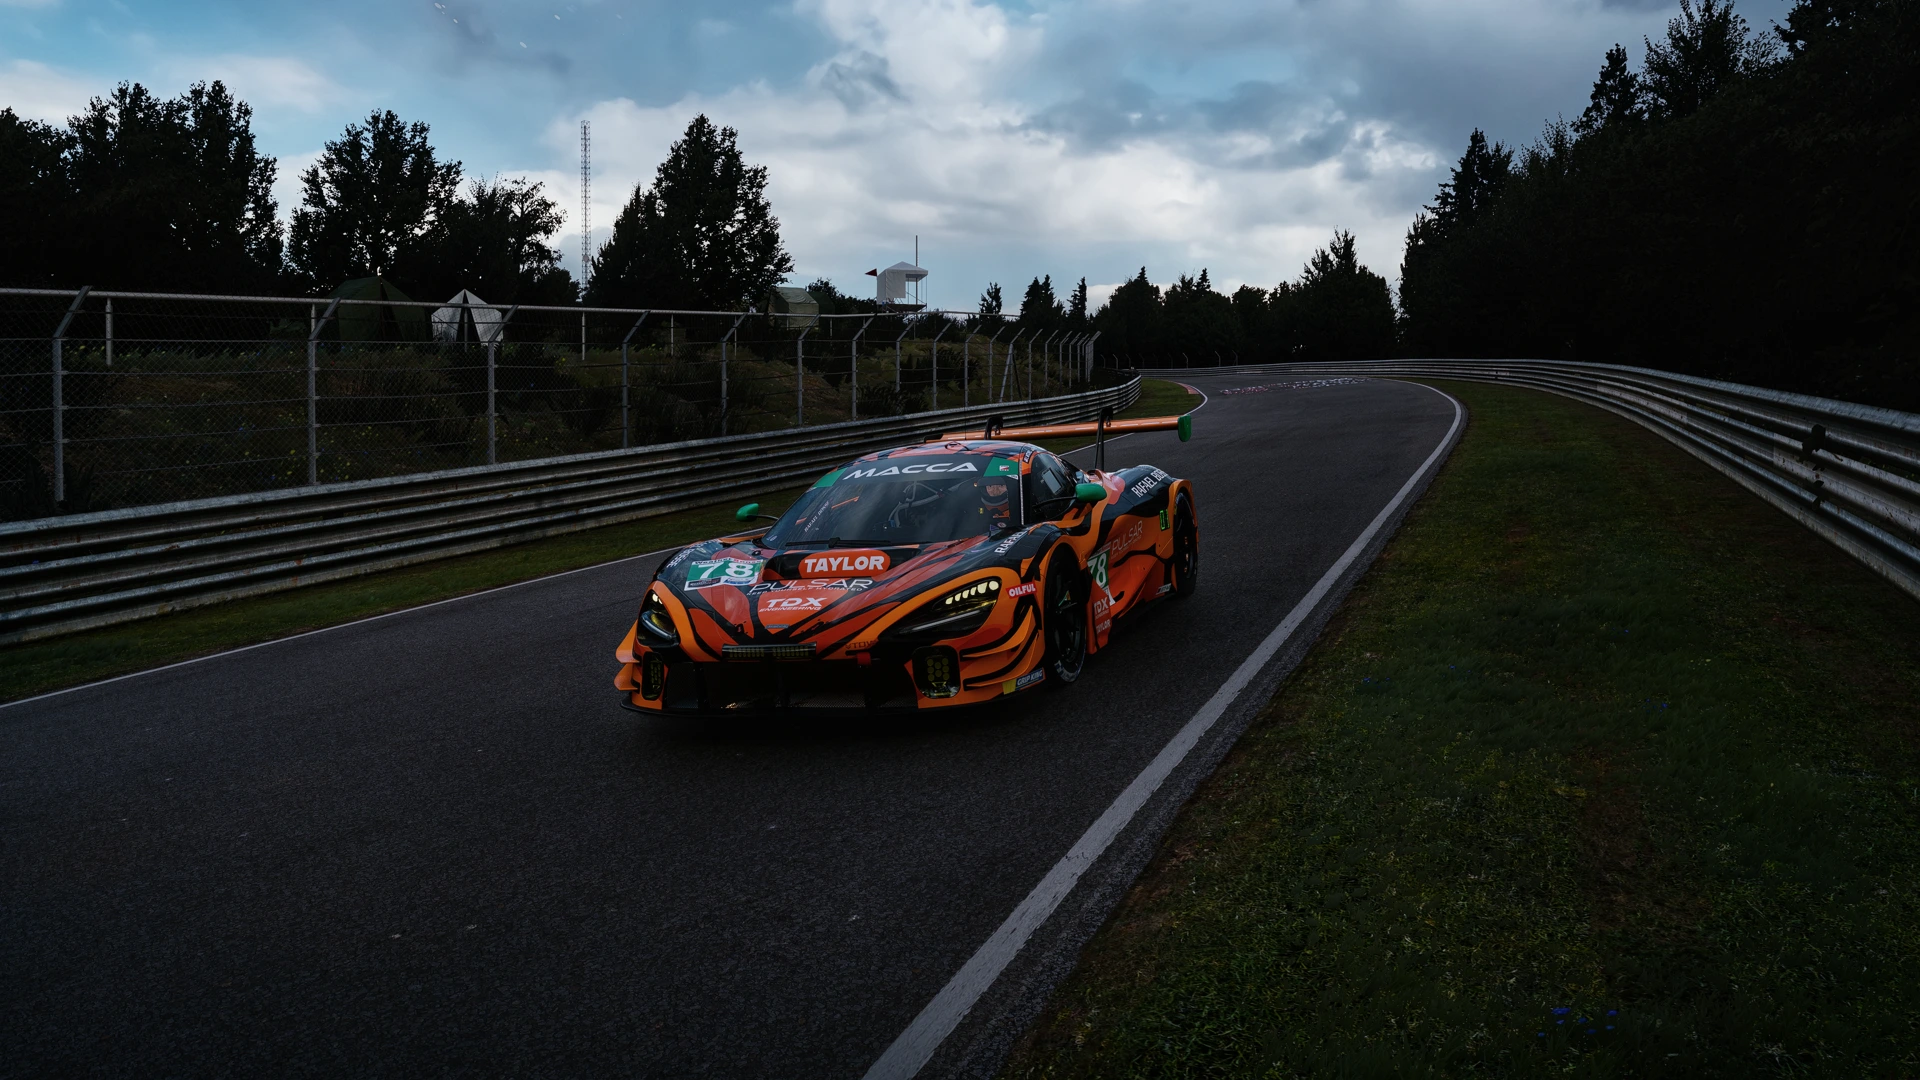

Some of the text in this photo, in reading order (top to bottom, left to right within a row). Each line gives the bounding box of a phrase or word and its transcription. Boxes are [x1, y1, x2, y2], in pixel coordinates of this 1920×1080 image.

[842, 462, 978, 480] MACCA
[1131, 476, 1158, 498] RAFAEL
[1112, 520, 1143, 555] PULSAR
[698, 560, 754, 579] 78
[804, 555, 885, 573] TAYLOR
[1087, 552, 1107, 589] 78
[749, 578, 873, 593] PULSAR
[1008, 583, 1036, 597] OILFUL
[766, 597, 827, 607] TDX
[1016, 673, 1031, 686] GRIP
[1030, 668, 1043, 681] KING
